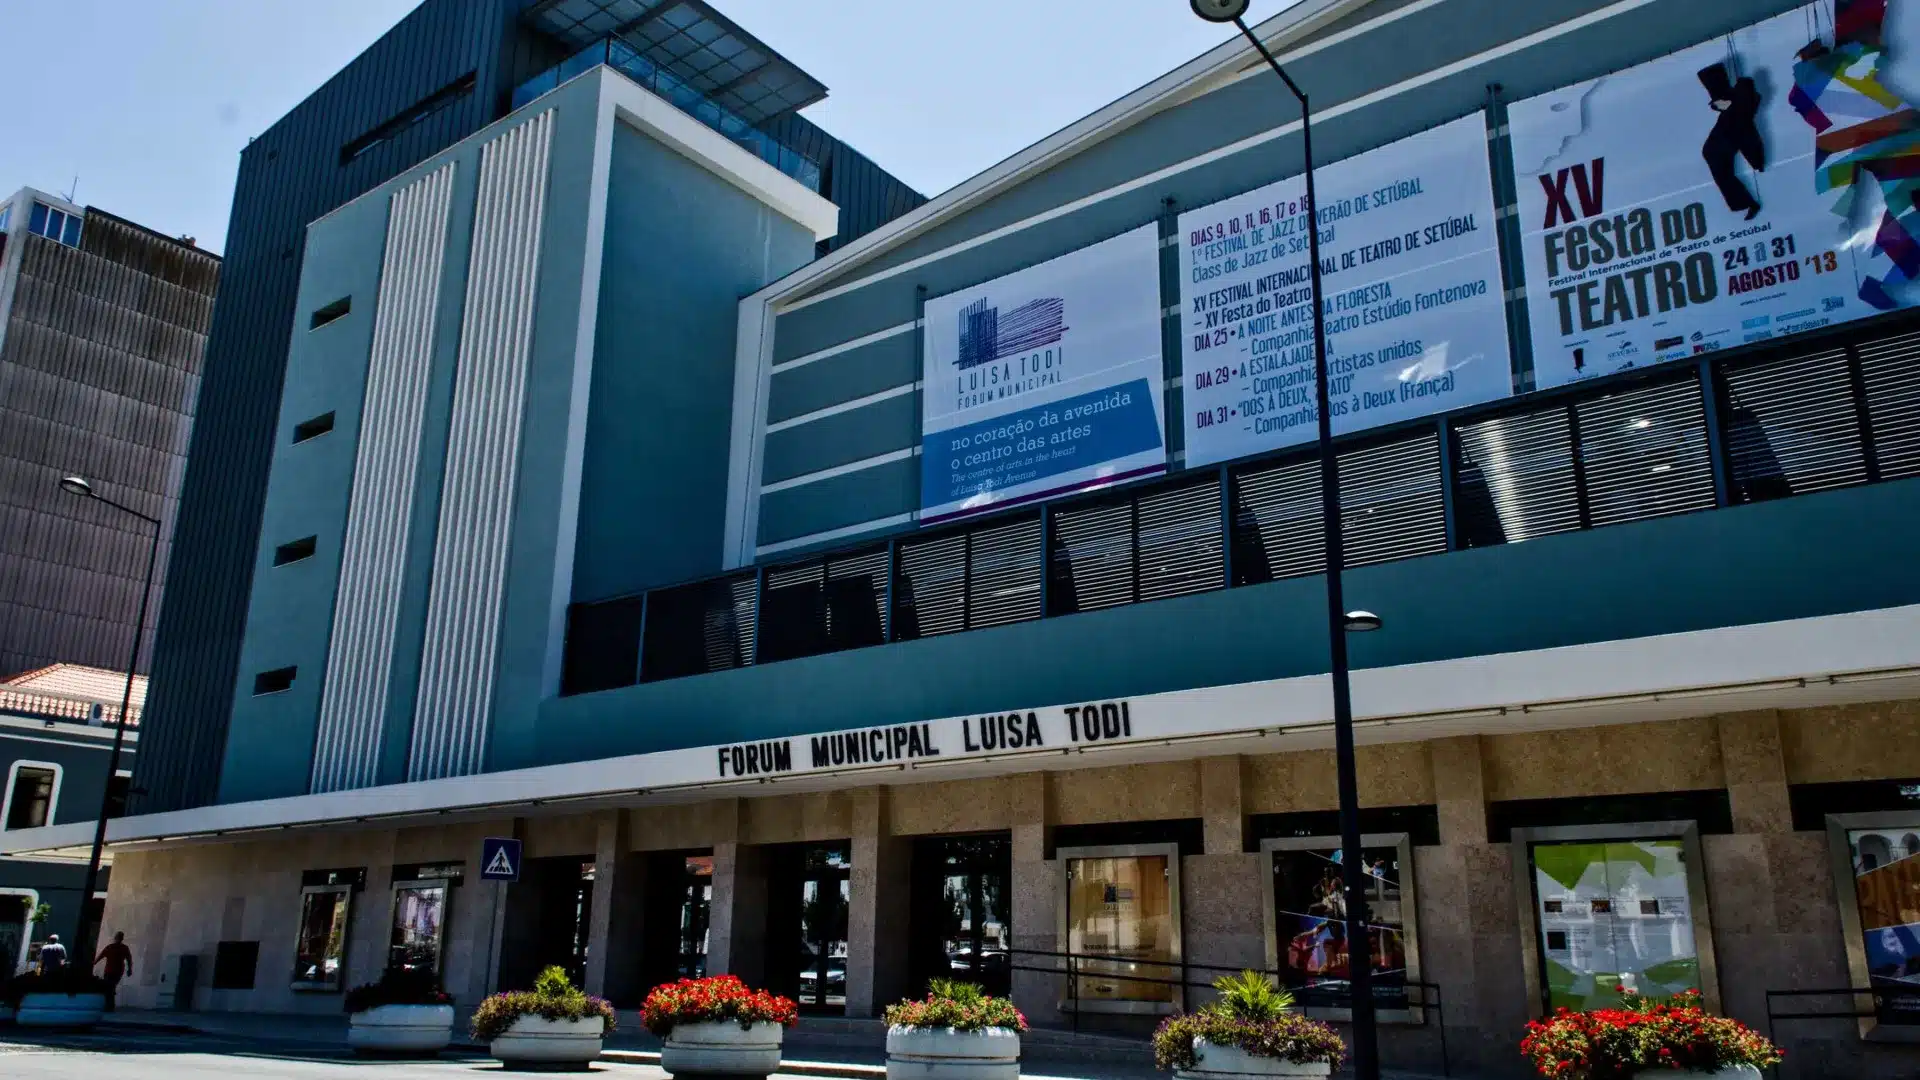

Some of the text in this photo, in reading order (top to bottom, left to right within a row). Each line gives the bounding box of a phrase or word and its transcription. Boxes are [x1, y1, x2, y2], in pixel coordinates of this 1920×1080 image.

[1191, 194, 1309, 247] DIAS 9, 10, 11, 16, 17 e 18
[1205, 232, 1248, 261] FESTIVAL
[1251, 228, 1265, 246] DE
[1268, 217, 1295, 241] JAZZ
[1299, 213, 1310, 231] D
[1316, 200, 1351, 226] VERÃO
[1355, 194, 1369, 214] DE
[1373, 178, 1424, 208] SETÚBAL
[1538, 156, 1605, 230] XV
[1192, 225, 1335, 284] Class de Jazz de Setbal
[1193, 213, 1478, 314] XV FESTIVAL INTERNACINAL DE TEATRO DE SETÚBAL
[1548, 222, 1772, 288] Festival Internacional de Teatro de Setúbal
[1723, 246, 1749, 271] 24
[1771, 233, 1796, 258] 31
[1728, 260, 1800, 296] AGOSTO
[1194, 332, 1211, 351] DIA
[1214, 327, 1227, 347] 25
[1238, 325, 1245, 340] A
[1248, 313, 1278, 337] NOITE
[1280, 304, 1315, 328] ANTES
[1336, 280, 1392, 312] FLORESTA
[1205, 286, 1312, 329] XV Festa do Teatro
[1252, 279, 1486, 355] Companhia eatro Estúdio Fontenova
[1550, 251, 1718, 337] TEATRO
[958, 347, 1062, 394] LUISA TODI
[958, 371, 1062, 410] FORUM MUNICIPAL
[1196, 338, 1334, 390] DIA 29 A ESTALAJADEA
[1253, 364, 1317, 395] Companhia
[1378, 339, 1423, 364] unidos
[951, 391, 1131, 450] no coração da avenida
[1197, 410, 1214, 429] DIA
[1217, 406, 1228, 424] 31
[1278, 386, 1311, 409] DEUX,
[1254, 404, 1319, 435] Companhia
[1363, 388, 1396, 410] Deux
[1400, 370, 1454, 403] (França)
[951, 424, 1091, 469] o centro das artes
[951, 446, 1076, 483] The centre of arts in the heart
[1003, 470, 1037, 484] Avenue
[718, 701, 1131, 777] FORUM MUNICIPAL LUISA TODI
